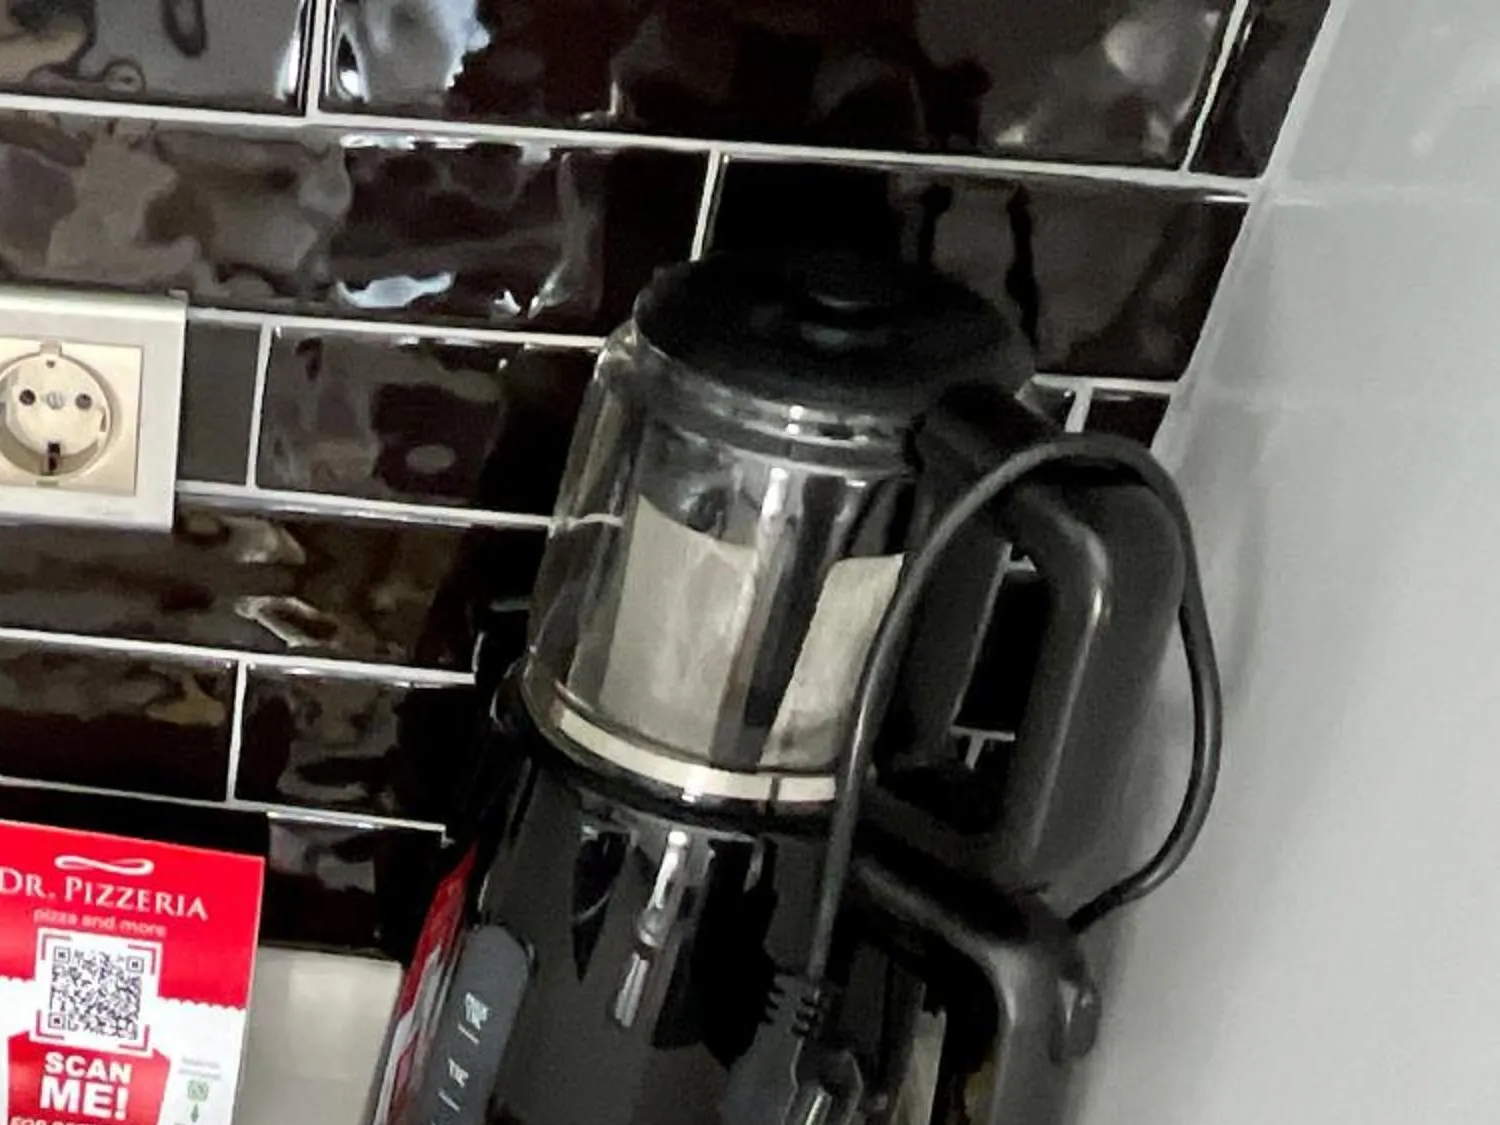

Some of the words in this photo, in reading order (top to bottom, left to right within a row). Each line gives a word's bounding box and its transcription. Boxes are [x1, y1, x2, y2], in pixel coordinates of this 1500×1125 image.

[63, 876, 209, 921] PIZZERIA
[33, 908, 77, 927] pizza
[81, 912, 115, 931] and
[119, 919, 167, 938] more
[44, 1052, 132, 1085] SCAN
[40, 1076, 129, 1120] ME!
